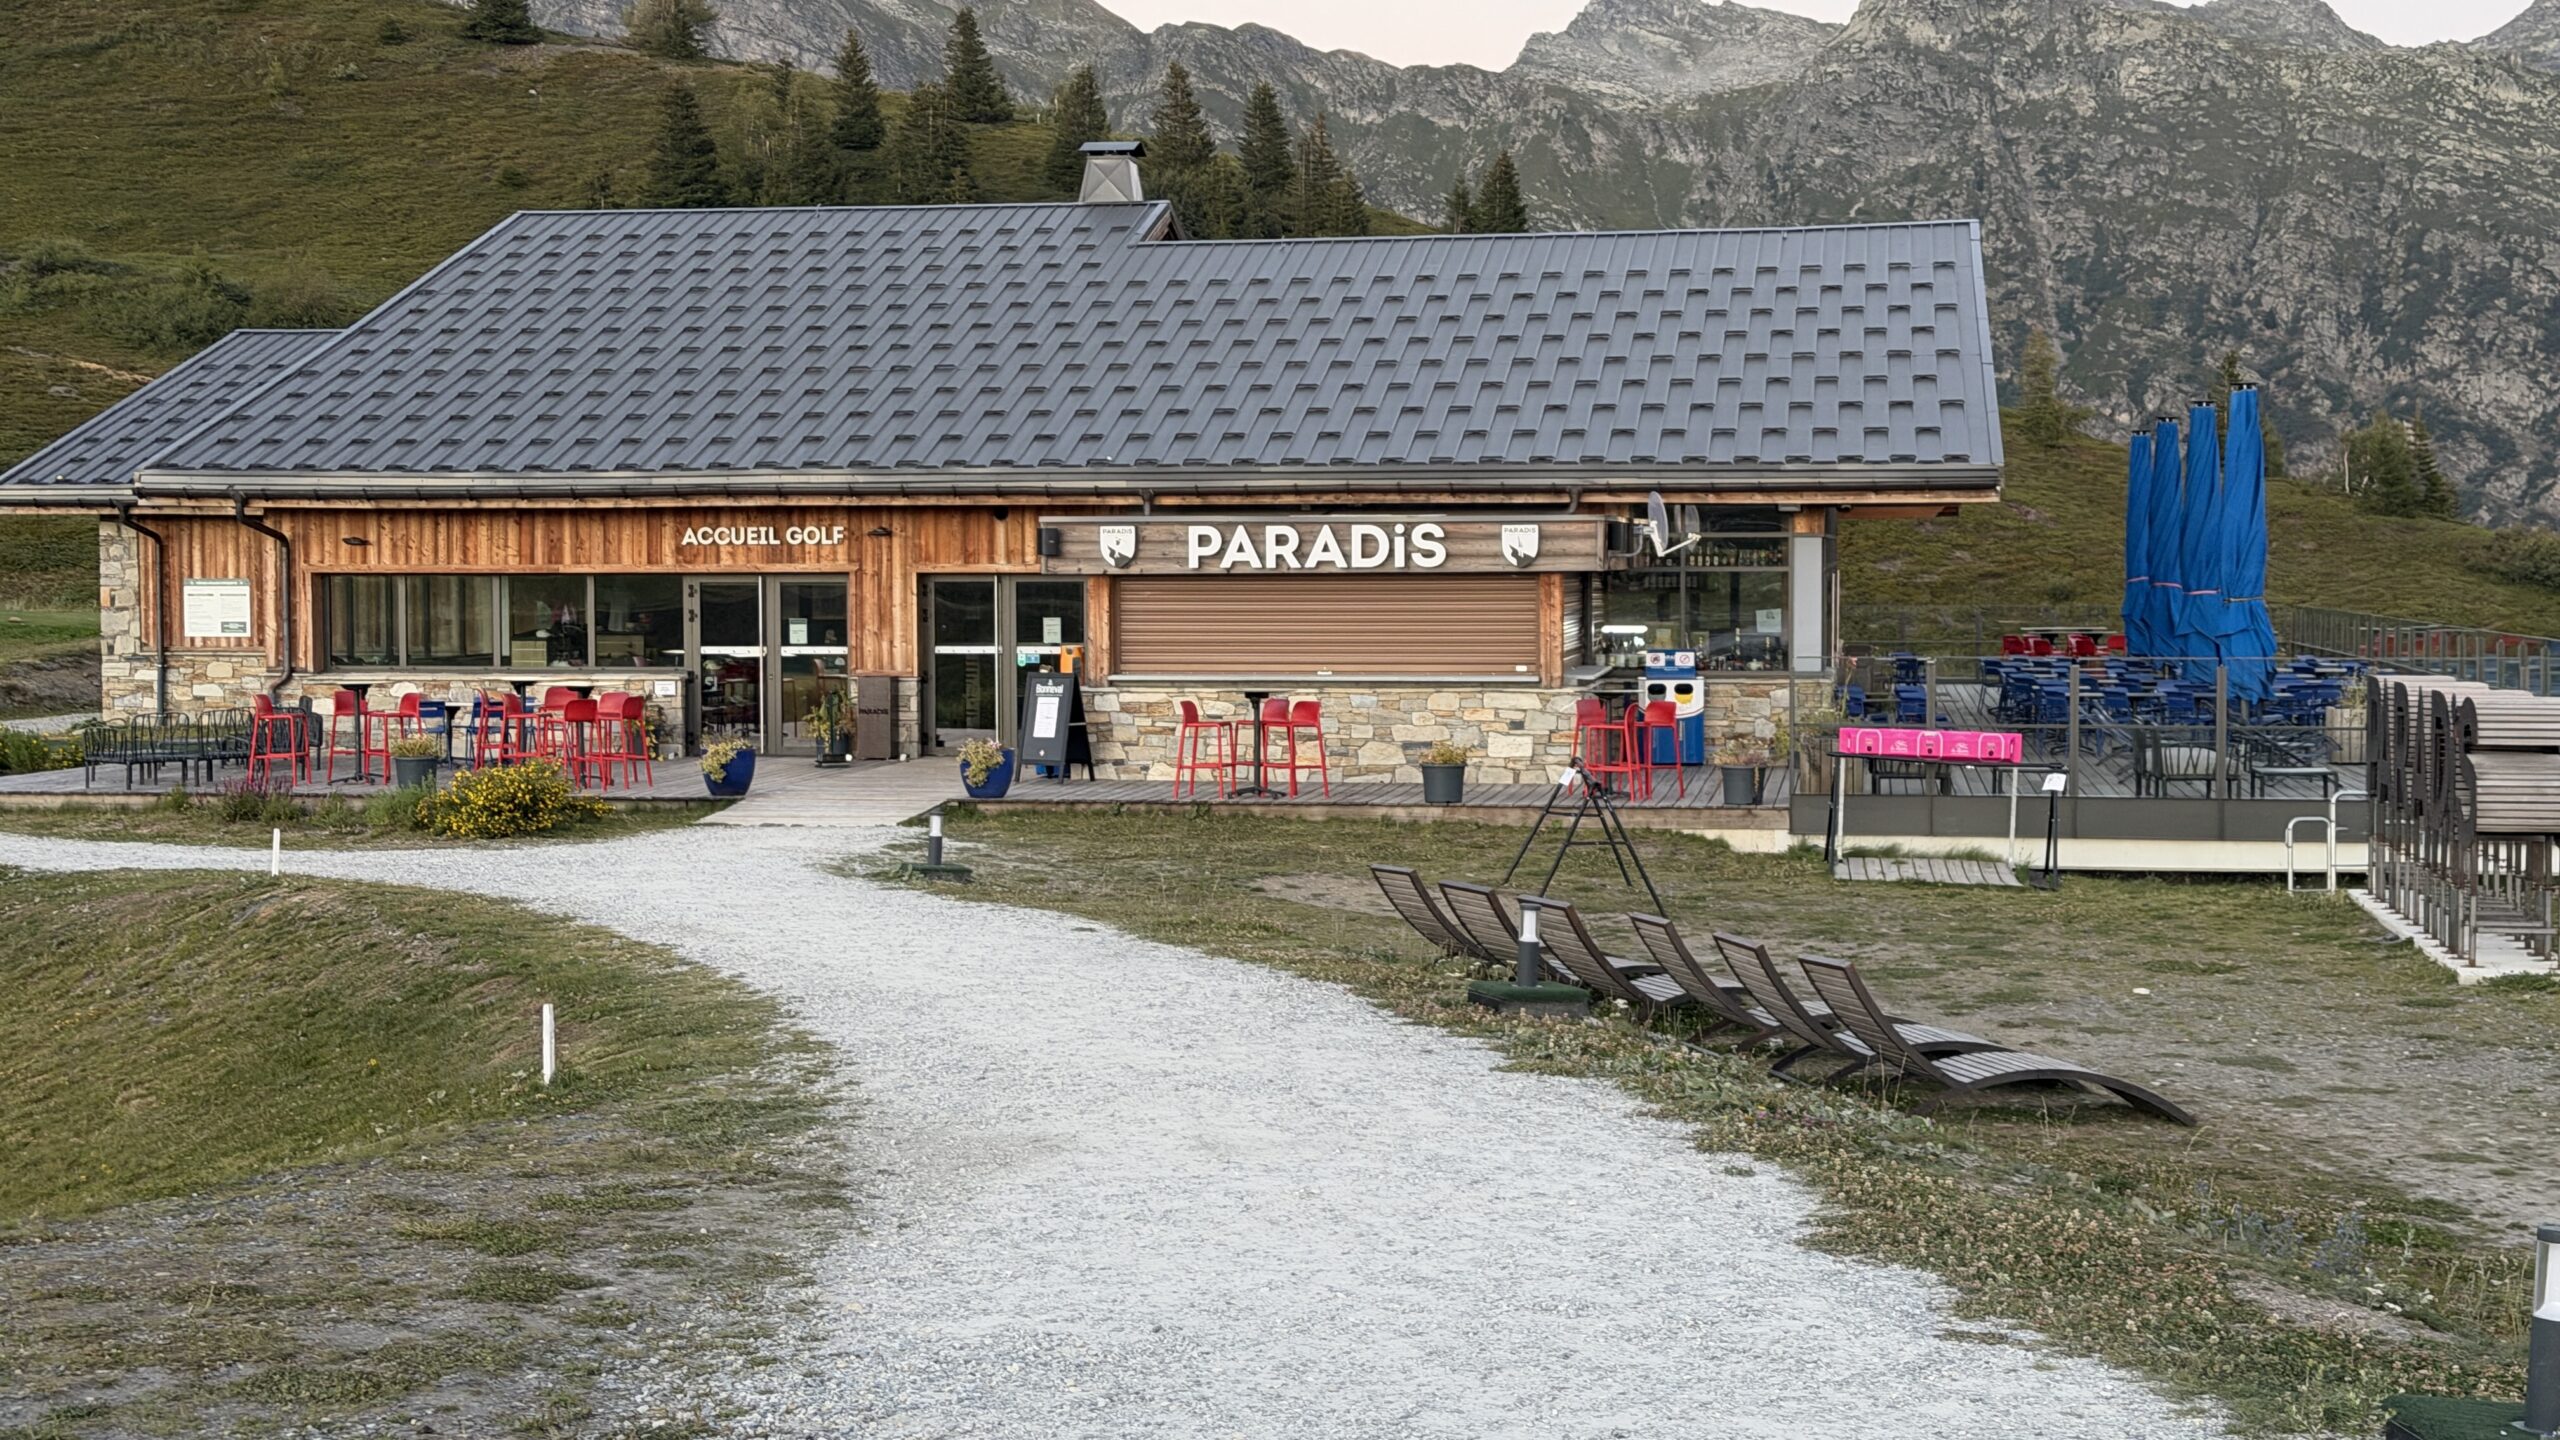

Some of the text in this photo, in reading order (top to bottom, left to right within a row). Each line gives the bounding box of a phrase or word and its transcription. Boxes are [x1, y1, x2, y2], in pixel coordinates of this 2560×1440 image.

[681, 526, 845, 545] ACCUEIL GOLF
[1188, 523, 1447, 569] PARADiS
